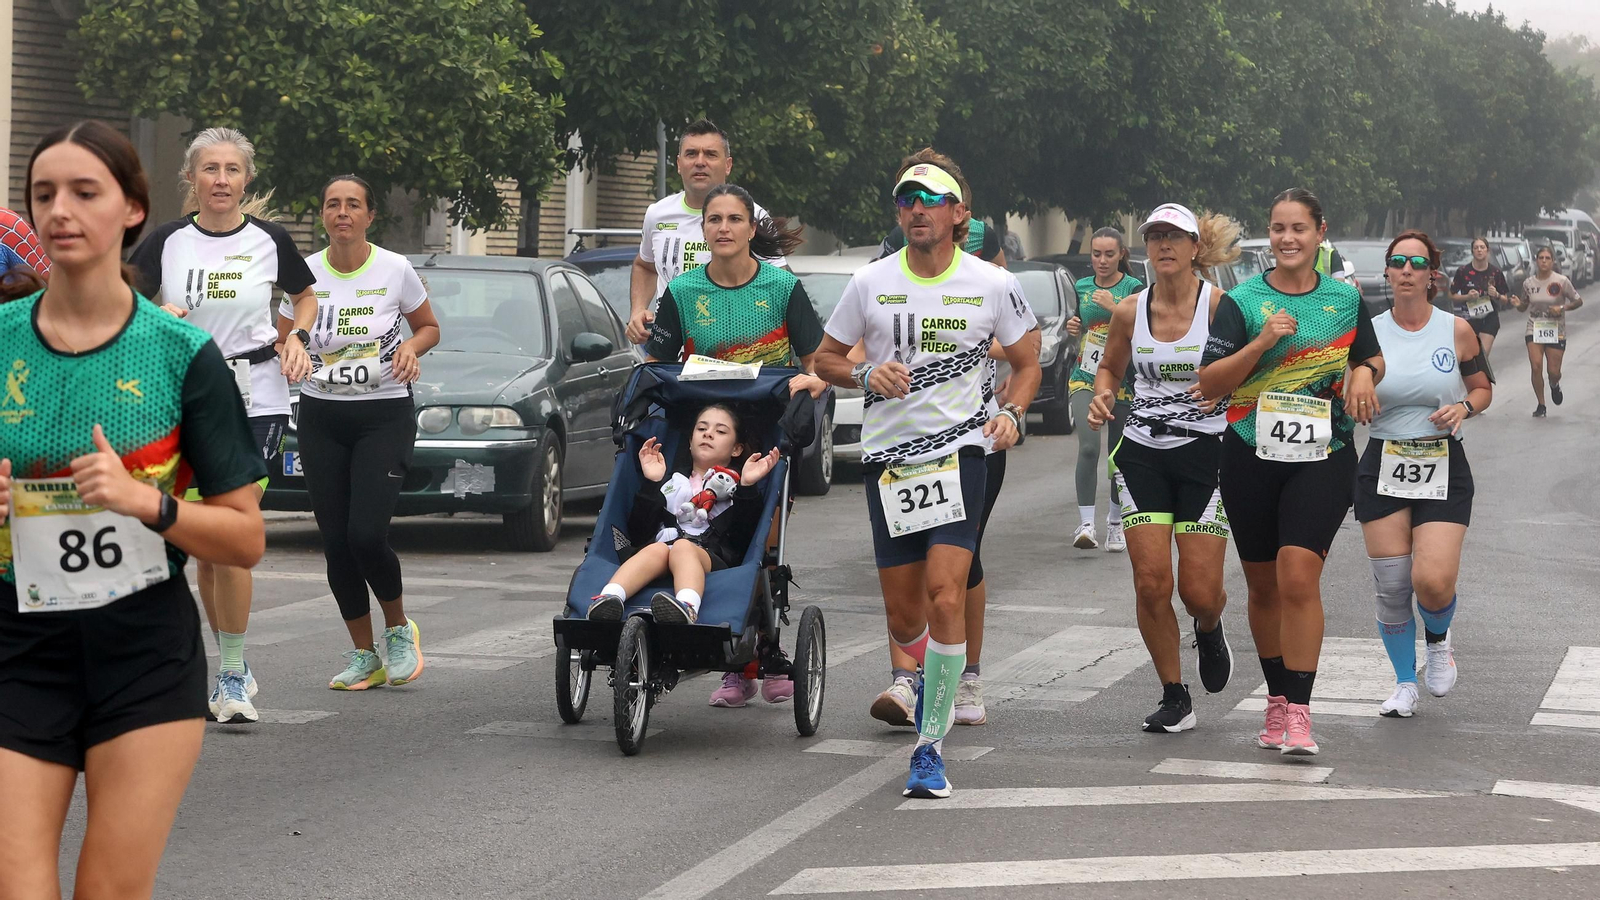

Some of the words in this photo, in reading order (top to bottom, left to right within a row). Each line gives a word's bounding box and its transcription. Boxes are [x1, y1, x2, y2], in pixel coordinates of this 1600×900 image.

[684, 253, 694, 262] DE
[208, 272, 243, 280] CARROS
[207, 290, 236, 299] FUEGO
[339, 307, 374, 316] CARROS
[1473, 304, 1489, 316] 251
[338, 318, 350, 326] DE
[921, 318, 967, 330] CARROS
[337, 327, 369, 336] FUEGO
[921, 331, 936, 341] DE
[1538, 329, 1554, 338] 168
[921, 343, 957, 353] FUEGO
[1159, 363, 1195, 372] CARROS
[326, 364, 370, 386] 150
[1266, 394, 1295, 402] CARRERA
[1296, 397, 1326, 407] SOLIDARIA
[1270, 420, 1317, 444] 421
[1392, 463, 1437, 484] 437
[24, 483, 77, 493] CARRERA
[897, 480, 949, 513] 321
[59, 526, 123, 573] 86
